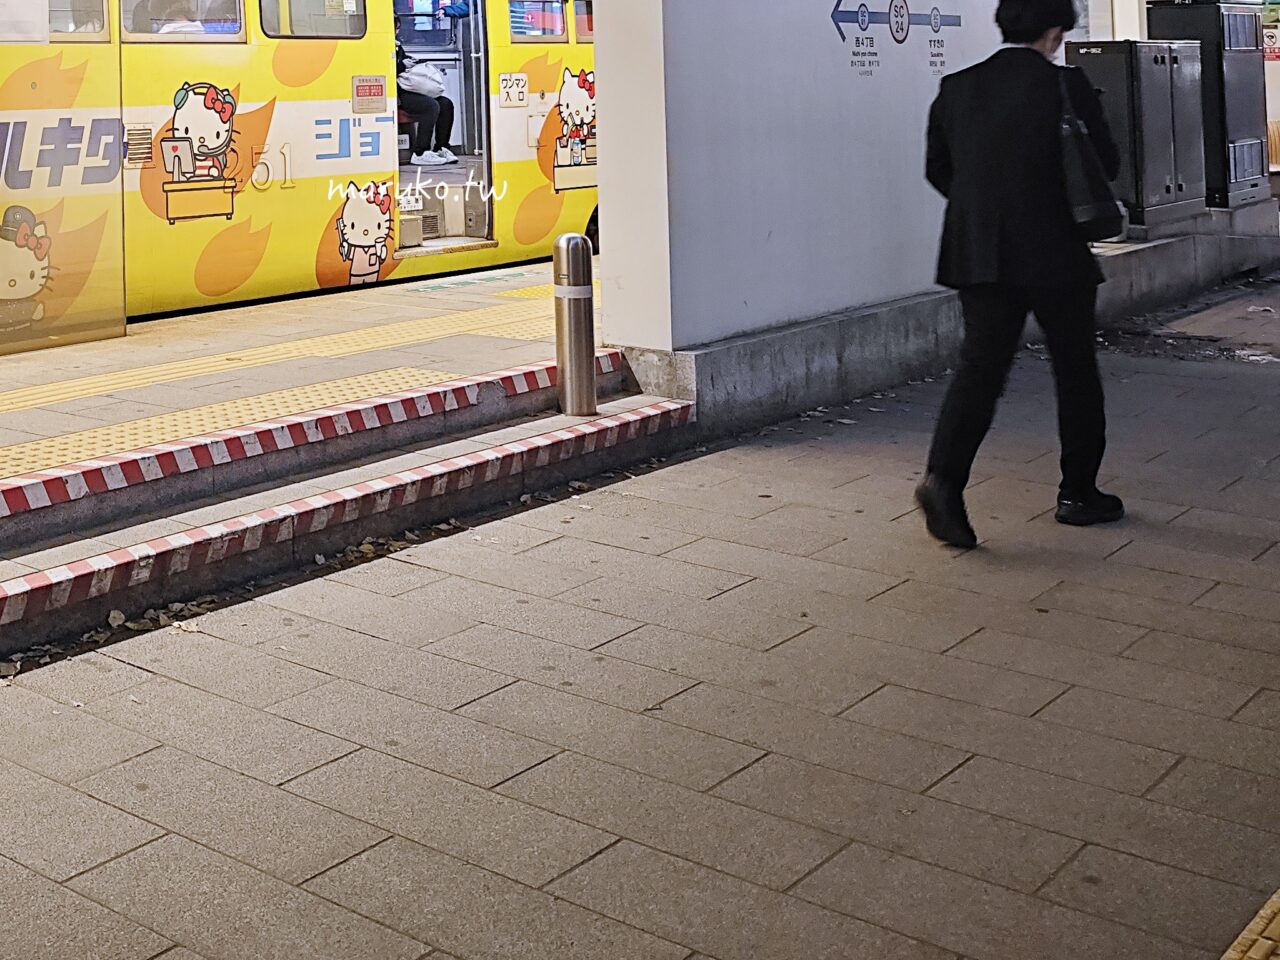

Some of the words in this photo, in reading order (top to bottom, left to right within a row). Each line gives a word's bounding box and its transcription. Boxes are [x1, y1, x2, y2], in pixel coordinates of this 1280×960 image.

[893, 4, 905, 19] SC
[895, 20, 904, 34] 24
[501, 78, 528, 90] ワンマン
[504, 91, 525, 102] 入口
